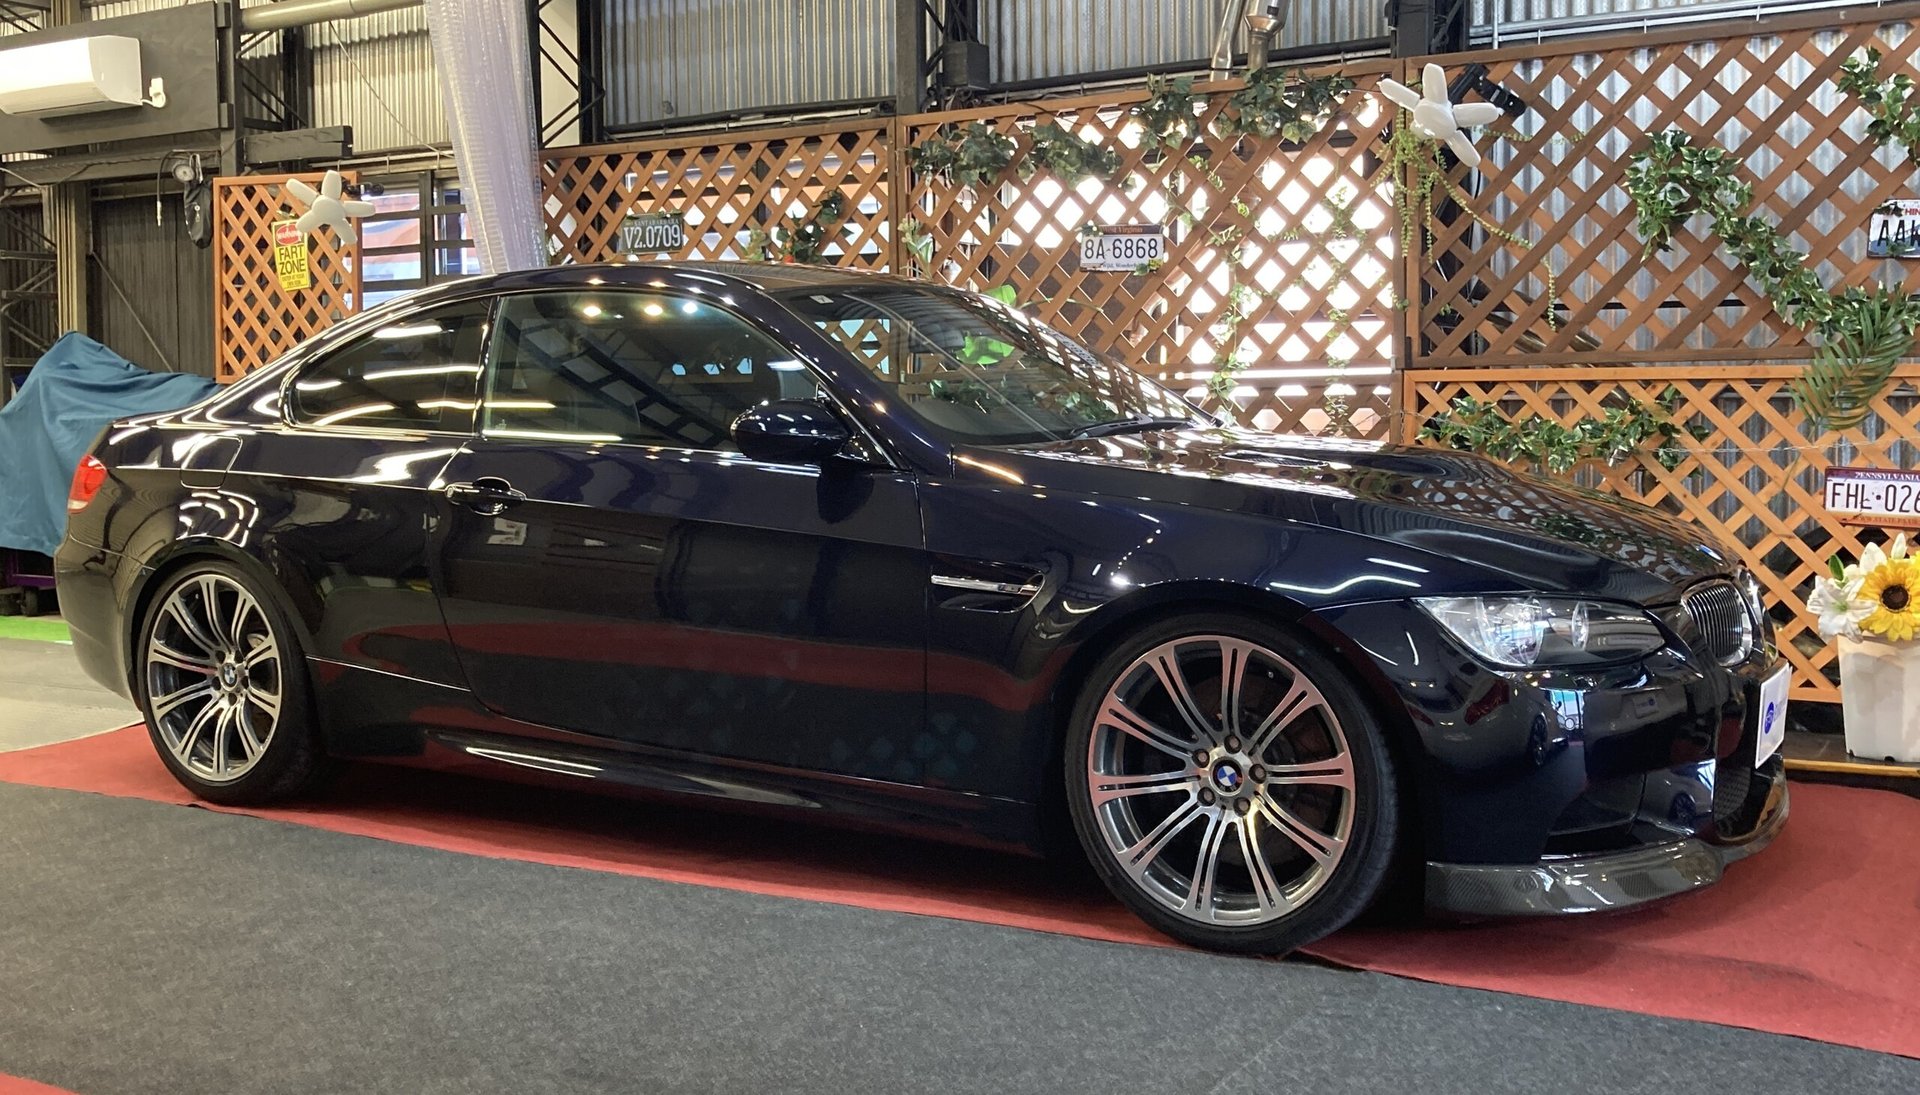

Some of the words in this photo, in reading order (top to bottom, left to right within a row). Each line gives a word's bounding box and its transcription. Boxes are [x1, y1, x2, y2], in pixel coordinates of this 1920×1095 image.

[623, 224, 681, 249] V2.0709
[278, 244, 305, 261] FART
[279, 258, 306, 276] ZONE
